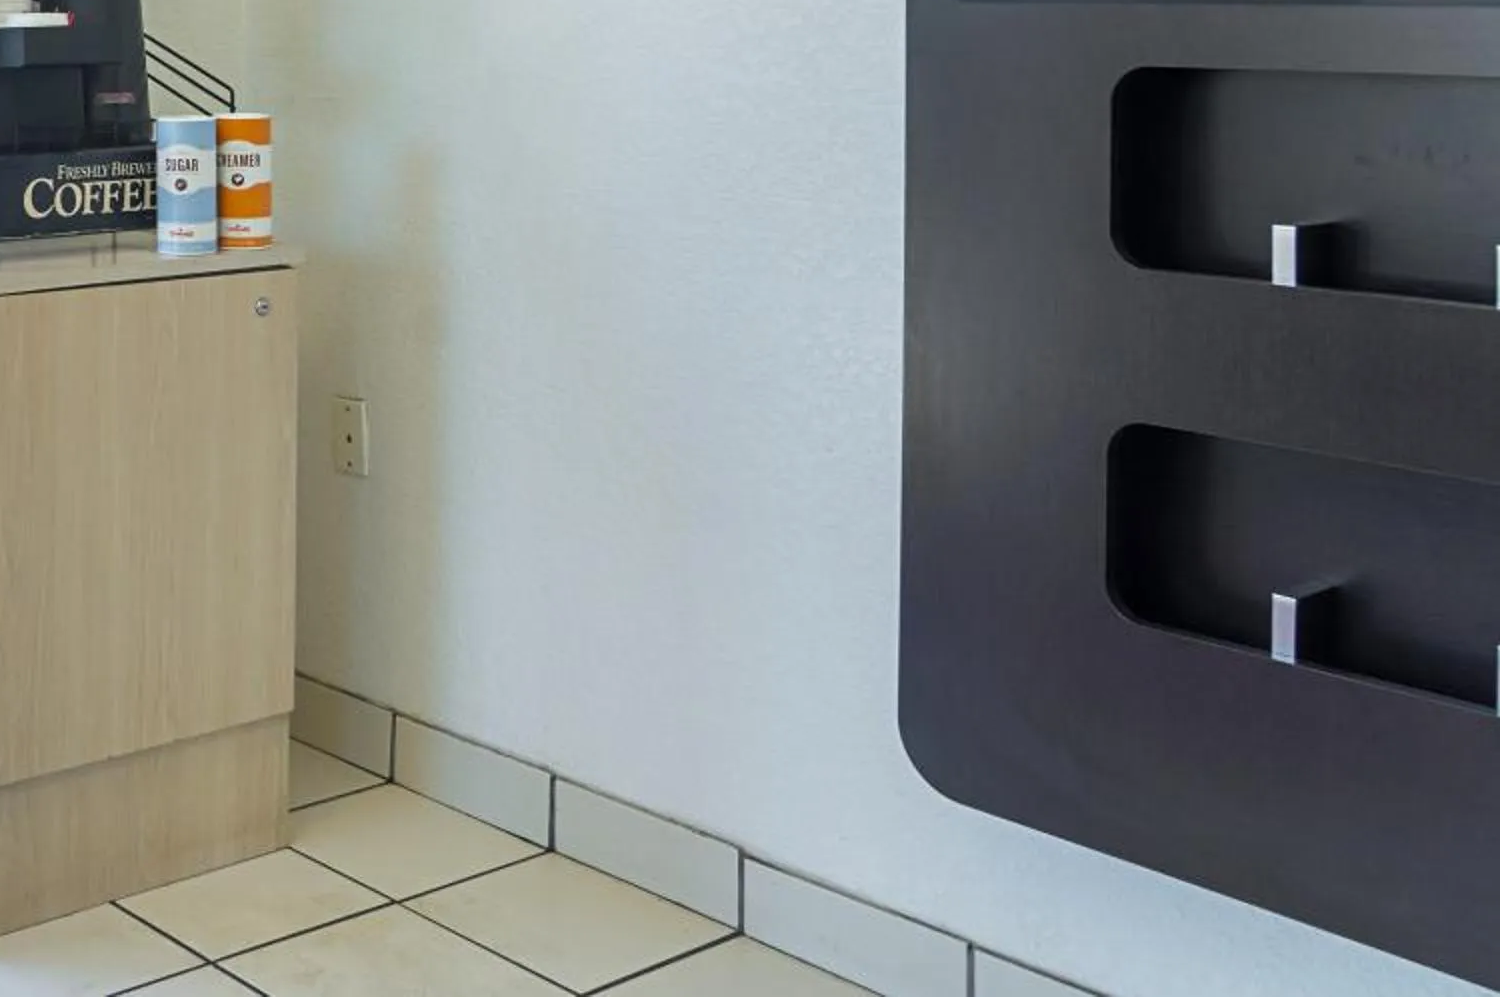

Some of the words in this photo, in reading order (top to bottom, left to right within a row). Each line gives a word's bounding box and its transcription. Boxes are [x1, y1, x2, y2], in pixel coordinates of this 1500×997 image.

[57, 163, 109, 180] FRESHLY
[111, 161, 157, 177] BREWE
[165, 158, 199, 172] SUGAR
[23, 177, 157, 220] COFFEE
